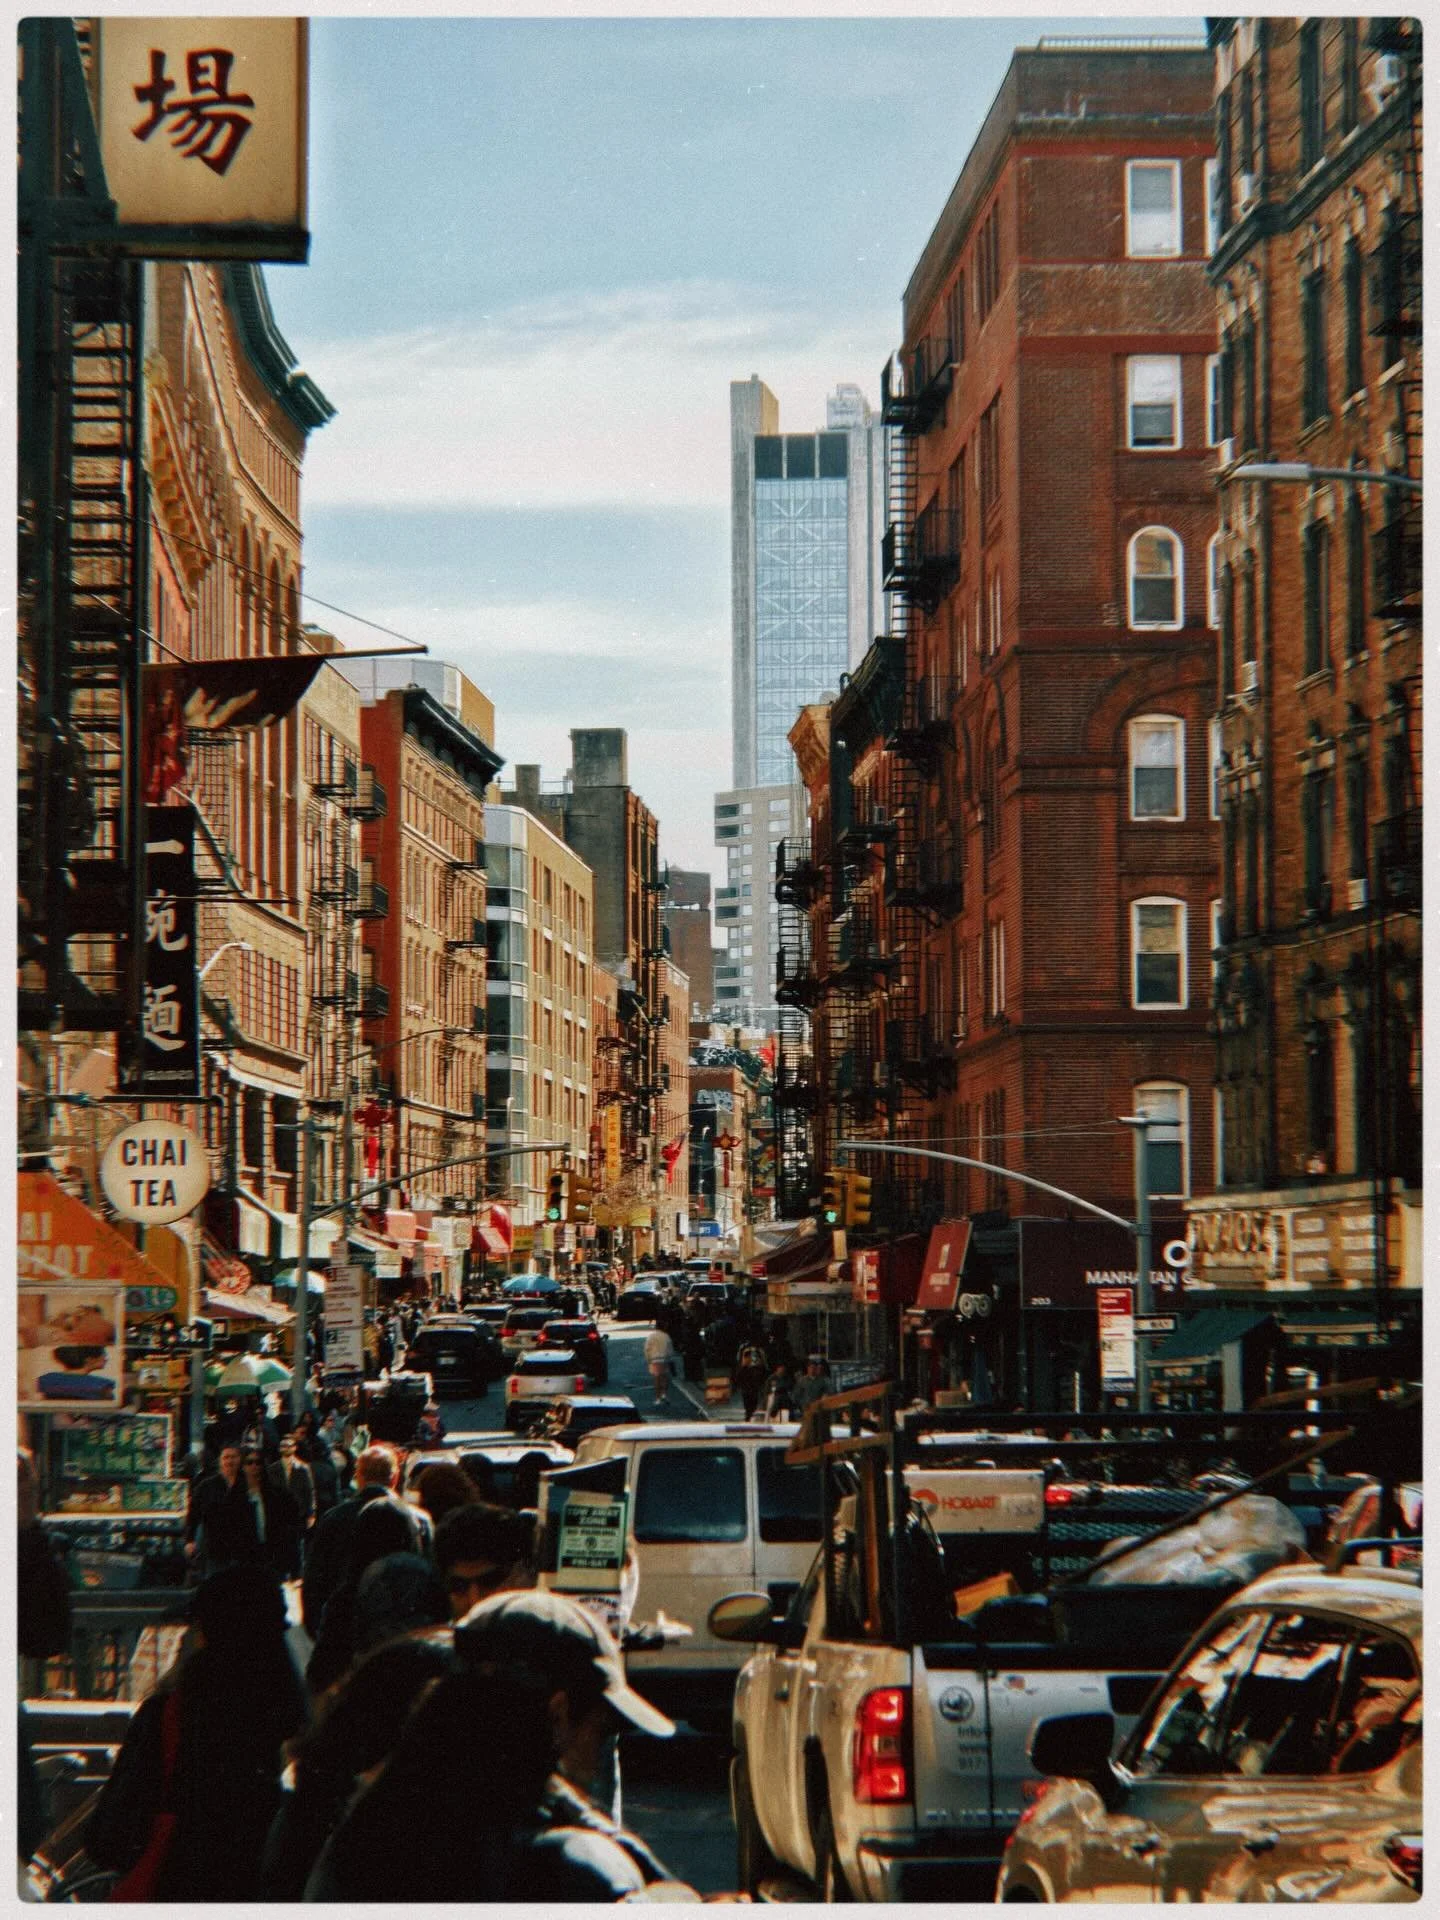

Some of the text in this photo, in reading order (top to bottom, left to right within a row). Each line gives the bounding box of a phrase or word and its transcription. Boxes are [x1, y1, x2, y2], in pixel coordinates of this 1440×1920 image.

[131, 48, 255, 177] 場
[120, 1139, 187, 1167] CHAI
[129, 1180, 177, 1207] TEA
[942, 1496, 997, 1510] HOBART
